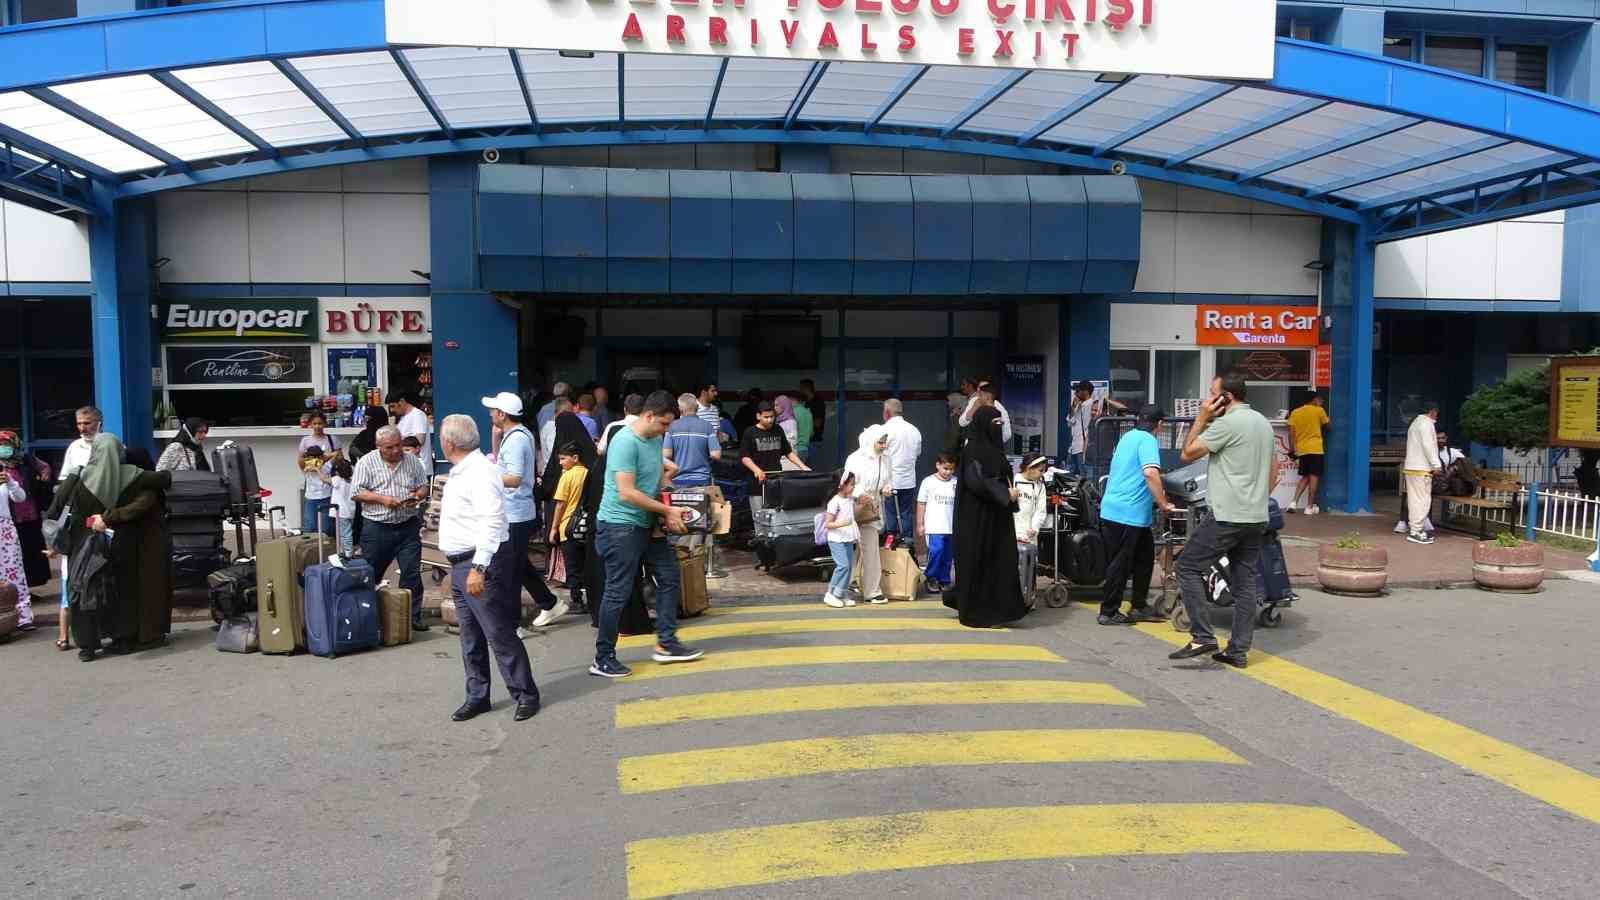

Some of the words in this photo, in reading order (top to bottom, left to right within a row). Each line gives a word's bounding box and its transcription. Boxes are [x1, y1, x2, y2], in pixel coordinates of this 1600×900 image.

[622, 12, 917, 53] ARRIVALS
[957, 27, 1080, 60] EXIT
[166, 303, 309, 336] Europcar
[326, 302, 424, 333] BÜFE
[1204, 310, 1256, 330] Rent
[1260, 314, 1273, 330] a
[1279, 310, 1316, 330] Car
[1243, 332, 1286, 344] Garenta
[203, 361, 250, 377] Rentline
